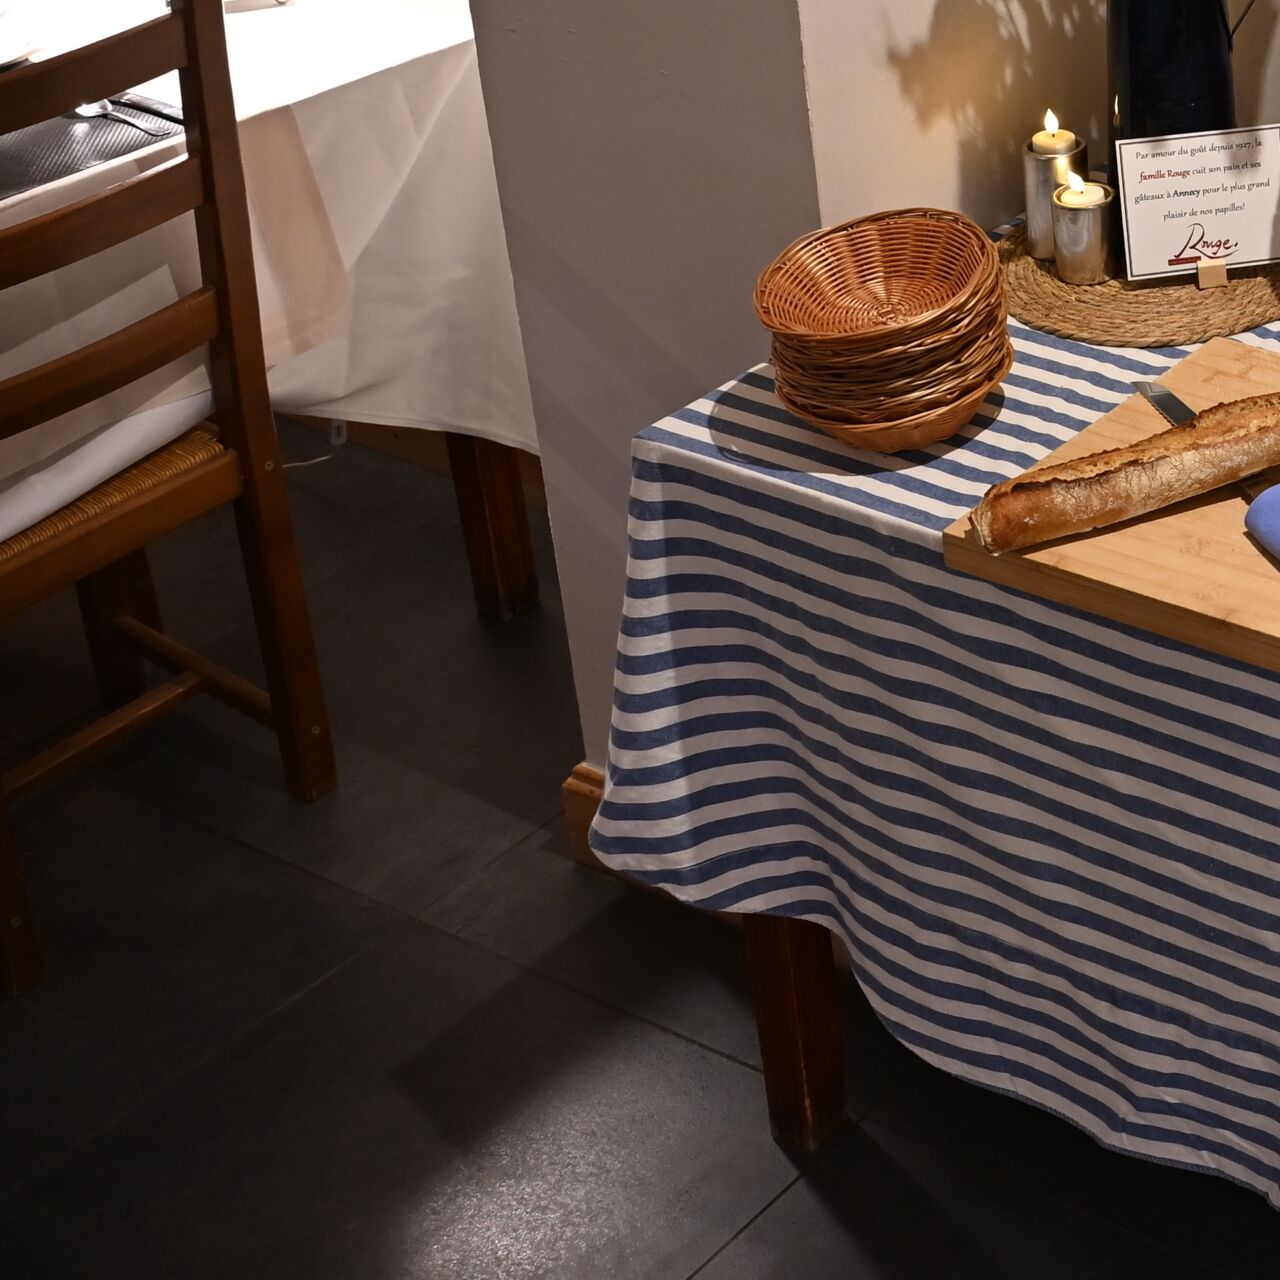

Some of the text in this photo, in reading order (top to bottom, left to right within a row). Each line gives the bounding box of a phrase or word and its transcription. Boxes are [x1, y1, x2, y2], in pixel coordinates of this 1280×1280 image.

[1135, 151, 1149, 160] Par
[1151, 150, 1176, 159] amour
[1178, 146, 1188, 155] du
[1190, 144, 1207, 157] goût
[1208, 142, 1234, 154] depuis
[1255, 138, 1262, 147] la
[1139, 169, 1166, 183] famille
[1167, 168, 1191, 180] Rouge
[1192, 165, 1206, 175] cuit
[1223, 162, 1240, 173] pain
[1241, 161, 1249, 170] et
[1250, 161, 1262, 169] ses
[1134, 177, 1270, 204] gâteaux à Annecy pour le plus grand
[1163, 202, 1245, 222] plaisir de nos papilles!
